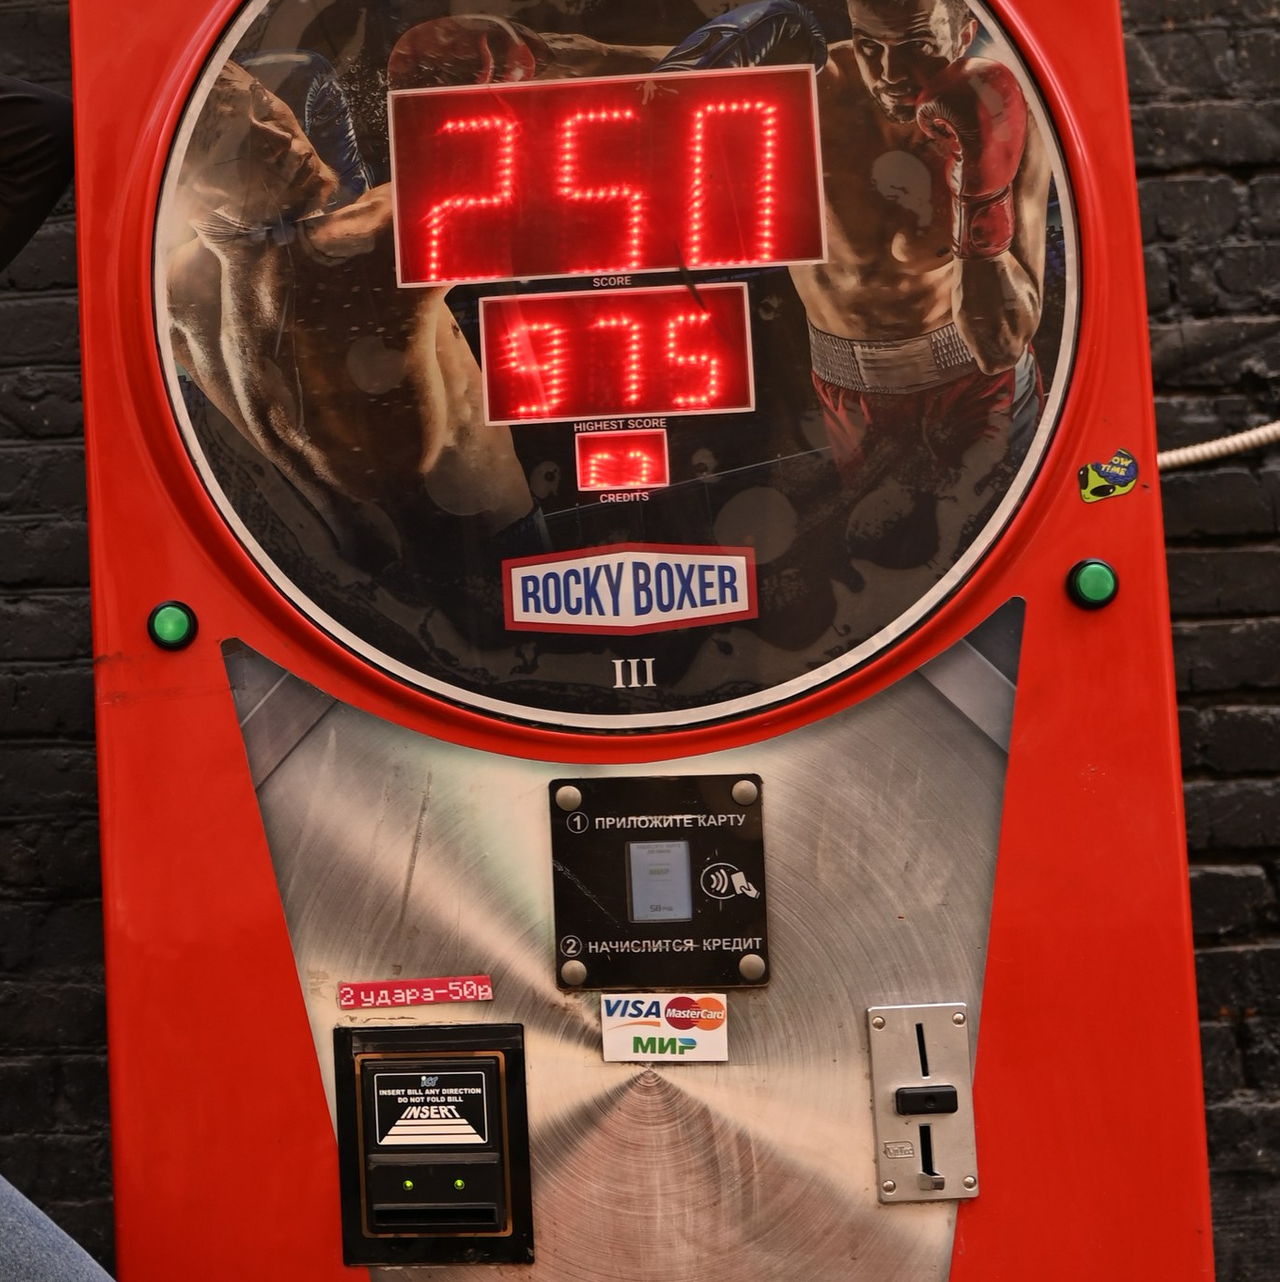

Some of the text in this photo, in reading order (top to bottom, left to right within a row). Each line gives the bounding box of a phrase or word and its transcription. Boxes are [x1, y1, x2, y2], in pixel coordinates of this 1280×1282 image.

[424, 100, 779, 281] 250
[592, 275, 632, 288] SCORE
[504, 313, 719, 414] 975
[573, 418, 667, 432] HIGHEST SCORE
[599, 491, 650, 504] CREDITS
[520, 561, 739, 617] ROCKY BOXER
[611, 657, 657, 689] III
[594, 815, 695, 830] ПРИЛОЖИТЕ
[697, 813, 746, 828] КАРТУ
[588, 938, 695, 954] НАЧИСЛИТСЯ
[702, 937, 763, 953] КРЕДИТ
[340, 986, 355, 1006] 2
[604, 999, 725, 1020] VISA MasterCard
[632, 1036, 697, 1055] МИР
[441, 1087, 482, 1095] DIRECTION
[400, 1105, 461, 1119] INSERT
